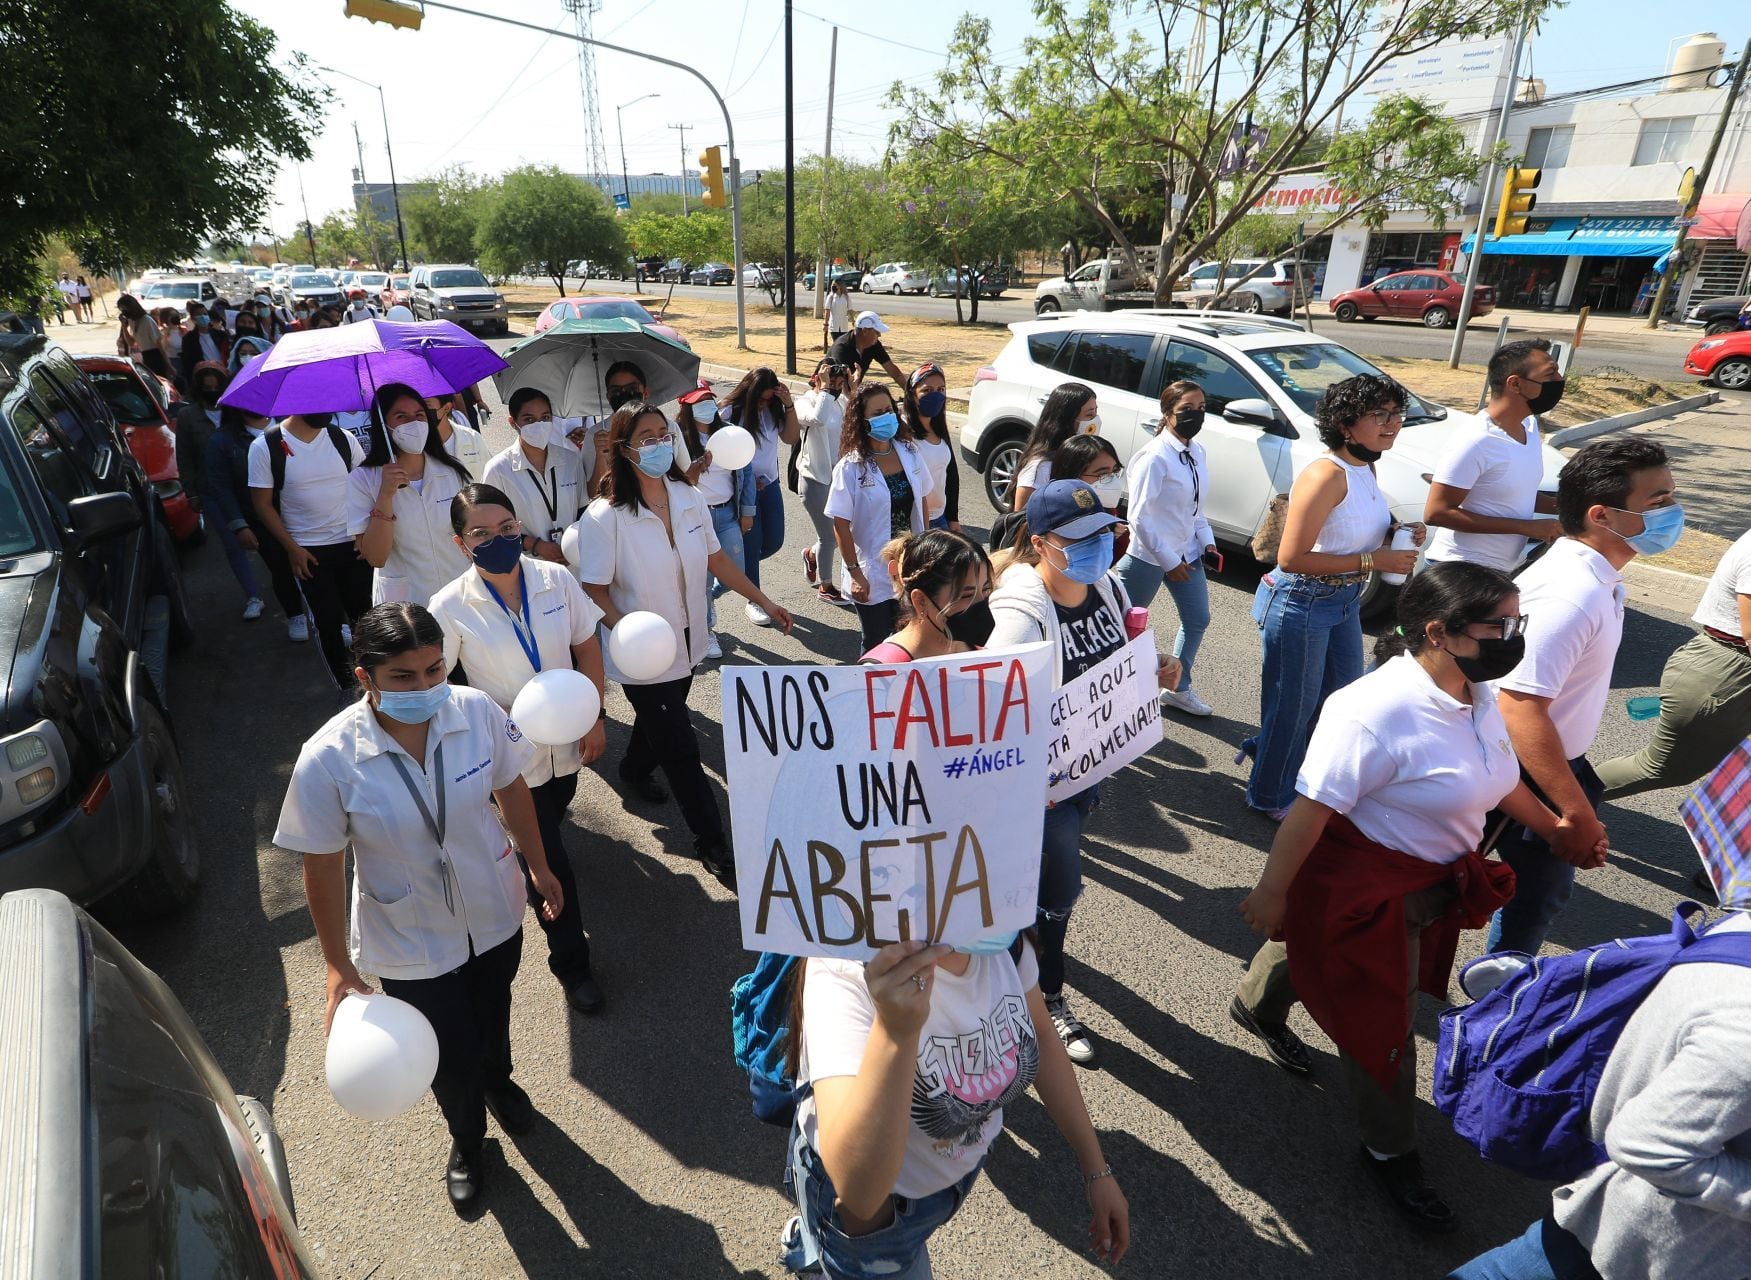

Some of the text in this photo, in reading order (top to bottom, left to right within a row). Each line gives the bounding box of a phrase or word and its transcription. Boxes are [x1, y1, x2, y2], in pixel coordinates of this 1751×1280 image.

[735, 659, 1030, 757] NOS FALTA
[1069, 697, 1160, 781] COLMENA!!!
[1088, 700, 1112, 729] TU
[836, 760, 932, 830] UNA
[943, 747, 1026, 779] #ÁNGEL
[755, 824, 994, 948] ABEJA
[917, 994, 1035, 1099] STONER
